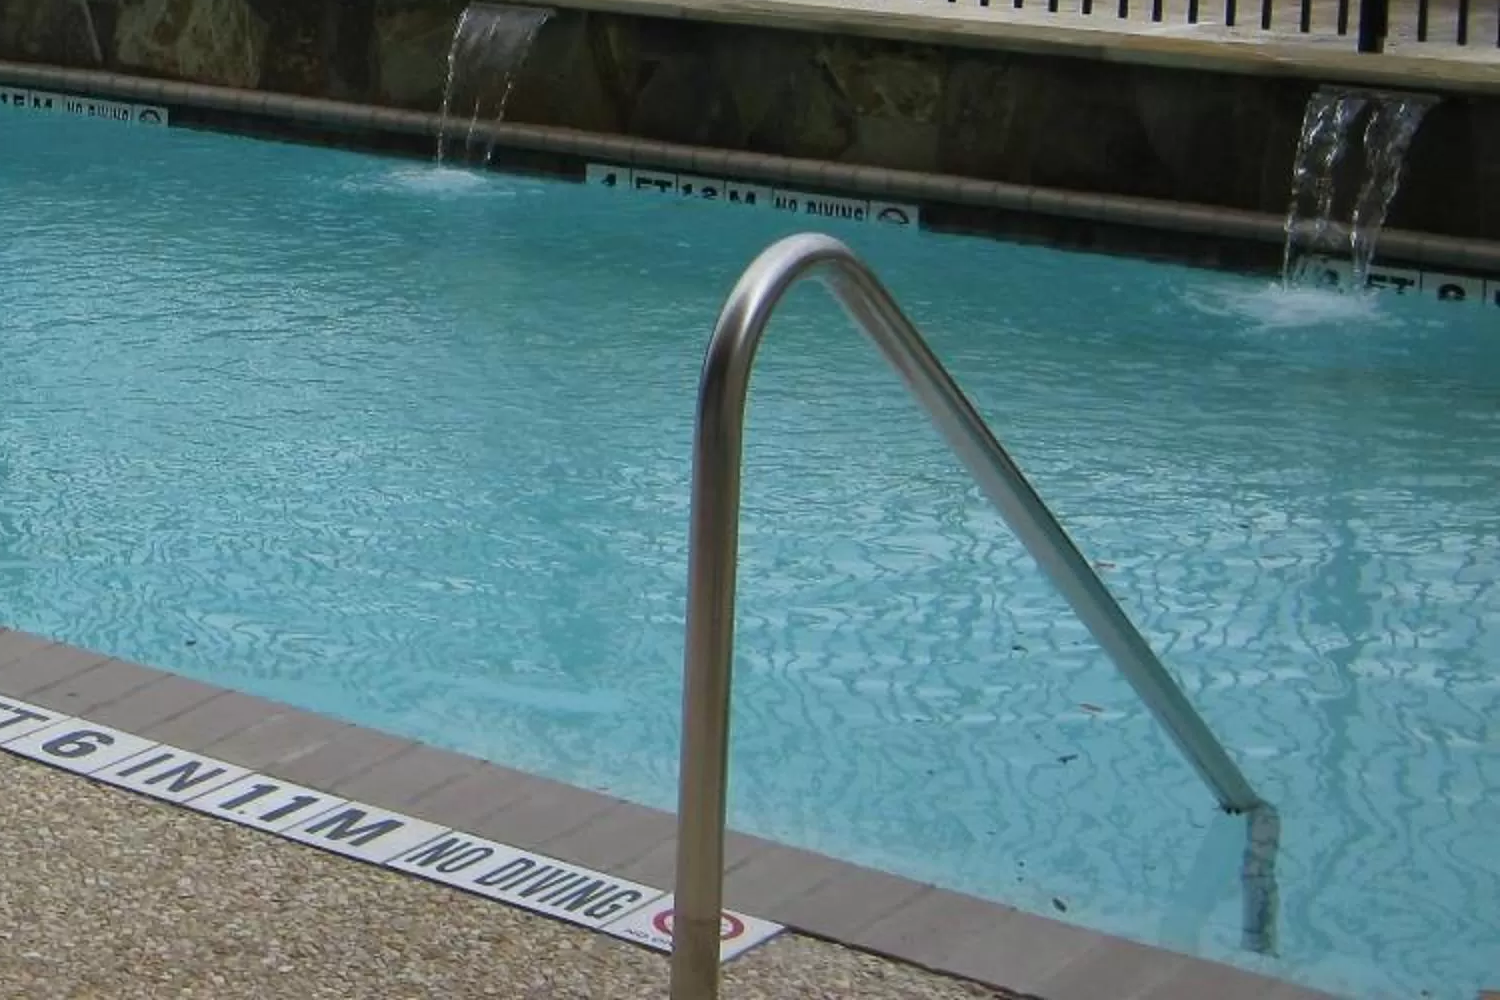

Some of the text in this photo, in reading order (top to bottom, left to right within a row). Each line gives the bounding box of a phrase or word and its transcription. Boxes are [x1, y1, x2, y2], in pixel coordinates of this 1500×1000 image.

[40, 729, 116, 759] 6
[116, 753, 227, 793] IN
[303, 807, 405, 847] M
[402, 837, 496, 873] NO
[473, 857, 643, 918] DIVING
